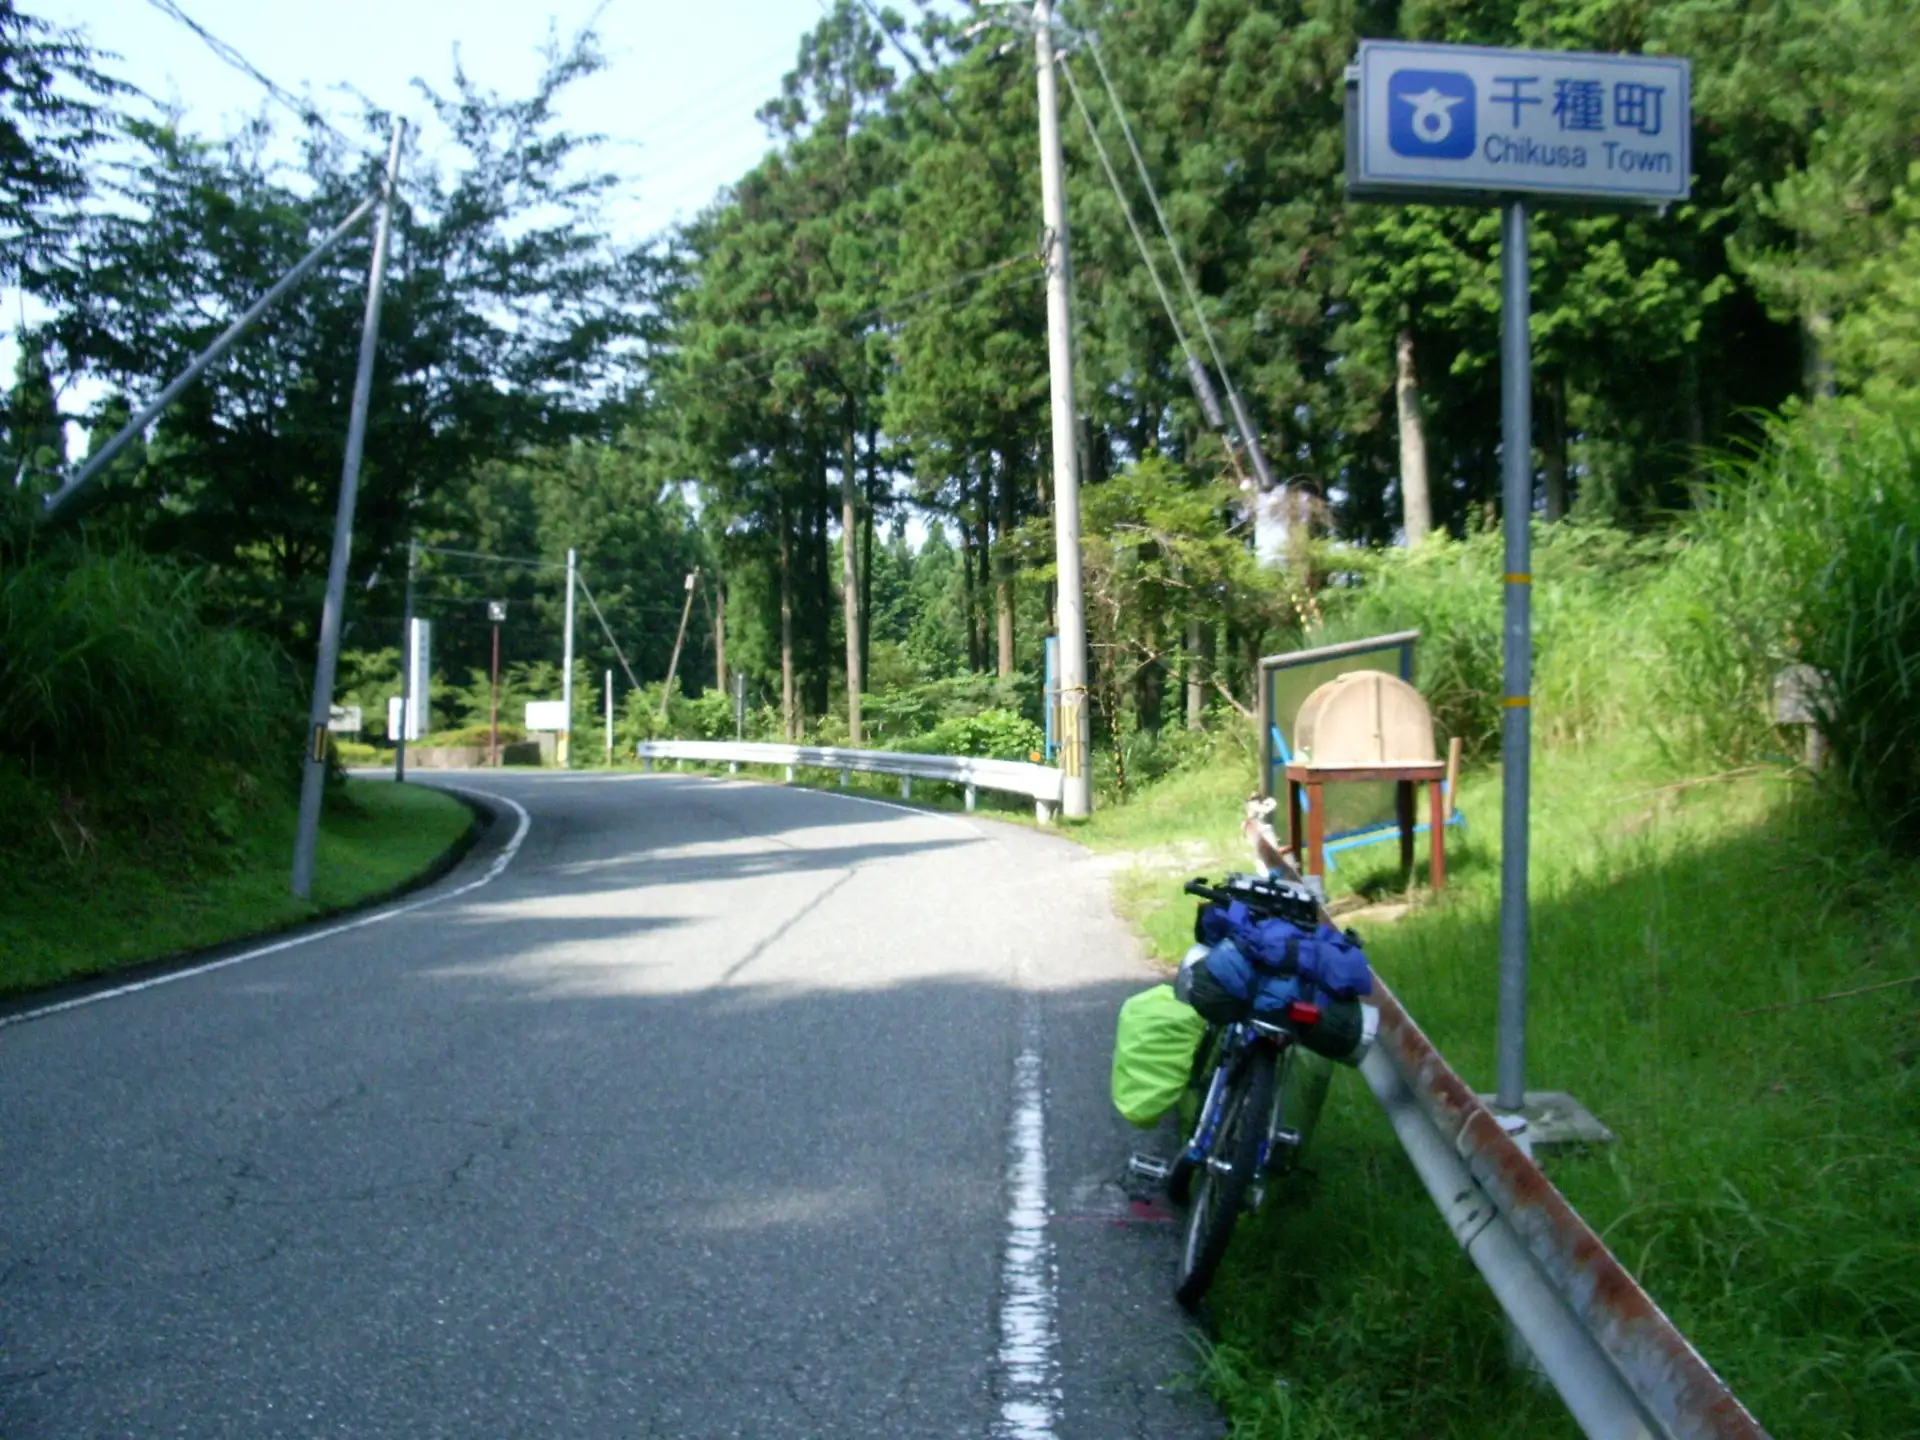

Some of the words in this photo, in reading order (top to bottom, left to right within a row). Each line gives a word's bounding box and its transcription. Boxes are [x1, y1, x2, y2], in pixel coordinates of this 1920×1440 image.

[1489, 76, 1666, 136] 千種町
[1484, 133, 1587, 169] Chikusa
[1602, 141, 1672, 174] Town
